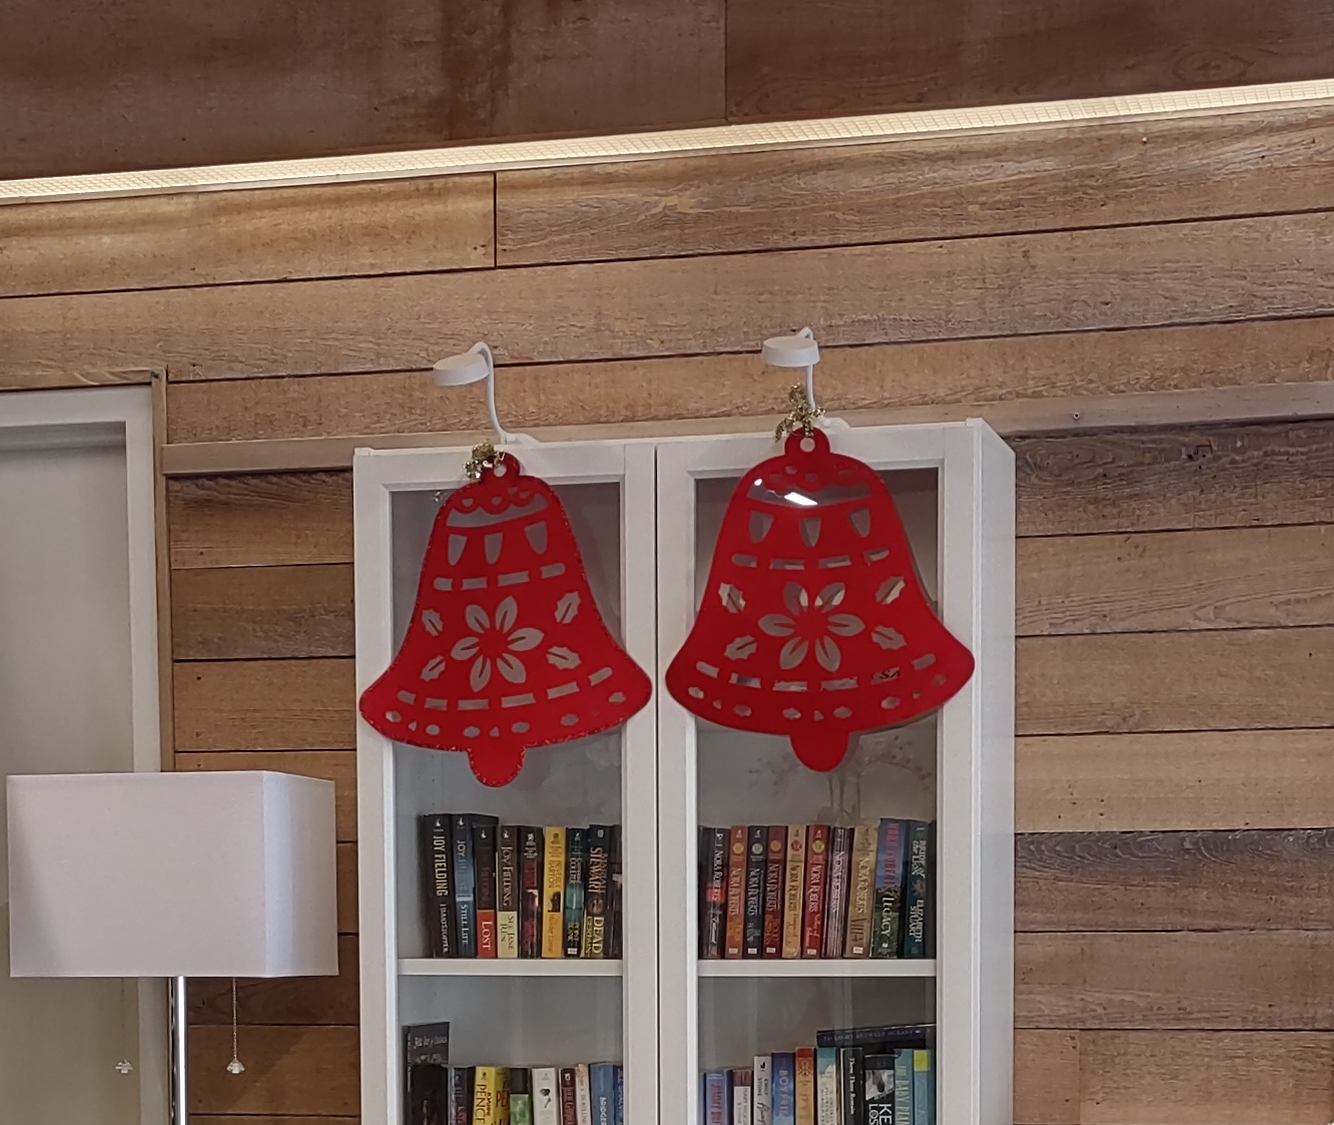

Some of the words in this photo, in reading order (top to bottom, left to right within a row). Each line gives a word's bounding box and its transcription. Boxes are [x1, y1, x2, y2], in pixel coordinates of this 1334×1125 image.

[433, 835, 445, 851] JOY
[456, 840, 466, 856] JOY
[500, 846, 513, 863] JOY
[588, 847, 603, 893] STEWART
[714, 849, 724, 870] NORA
[768, 863, 780, 881] NORA
[833, 851, 845, 876] NORA
[858, 857, 870, 880] NORA
[434, 854, 449, 897] FIELDING
[502, 866, 514, 907] FIELDING
[712, 871, 723, 901] ROBERTS
[730, 868, 741, 886] NORA
[749, 868, 761, 886] NORA
[789, 864, 800, 883] NORA
[810, 864, 822, 883] NORA
[728, 887, 740, 915] ROBERTS
[747, 888, 759, 916] ROBERTS
[766, 883, 778, 911] ROBERTS
[788, 885, 799, 912] ROBERTS
[808, 885, 820, 912] ROBERTS
[855, 881, 868, 914] ROBERTS
[460, 904, 469, 926] STILL
[881, 897, 895, 937] LEGACY
[909, 905, 918, 937] STUART
[914, 899, 925, 943] ELIZABETH
[481, 921, 493, 951] LOST
[500, 923, 508, 943] RUN
[592, 915, 605, 954] DEAD
[474, 1083, 487, 1124] PENCE
[895, 1079, 909, 1102] BABY
